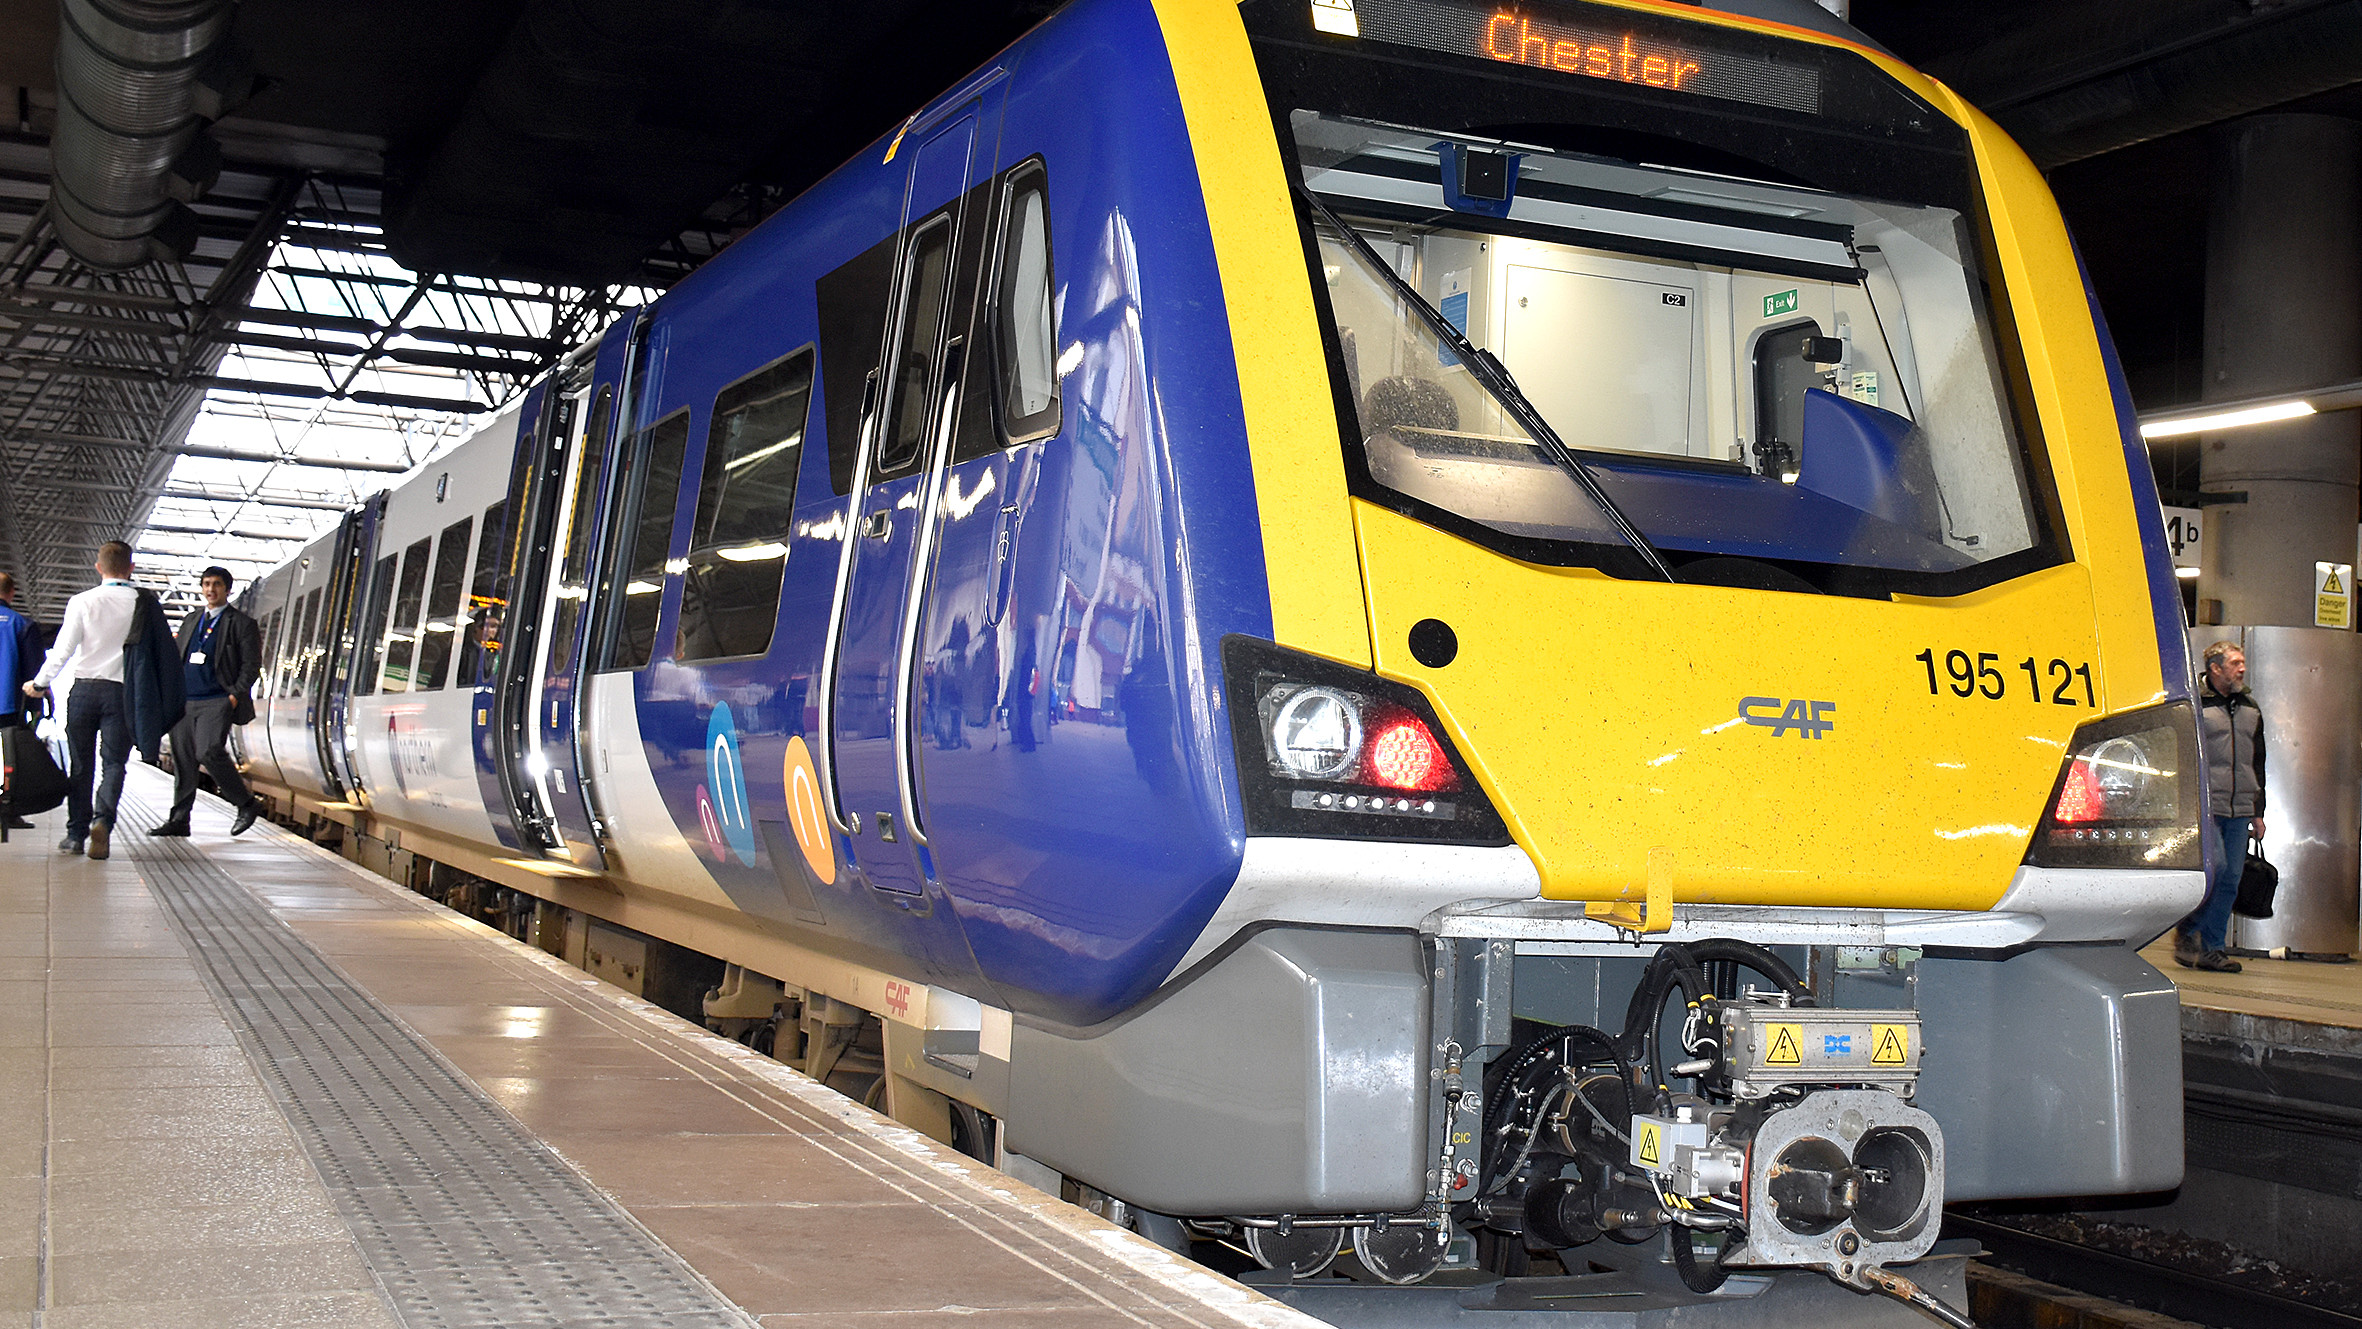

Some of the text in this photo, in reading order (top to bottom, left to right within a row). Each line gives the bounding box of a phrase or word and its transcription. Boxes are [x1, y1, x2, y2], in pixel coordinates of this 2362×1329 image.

[1488, 13, 1699, 89] Chester
[1665, 293, 1682, 306] C2
[1775, 300, 1785, 309] Exit
[2166, 516, 2199, 556] 4b
[2319, 597, 2346, 609] Danger
[1915, 647, 2096, 708] 195 121
[1738, 696, 1836, 740] CAF
[885, 980, 911, 1018] CAF
[1452, 1132, 1471, 1144] CIC
